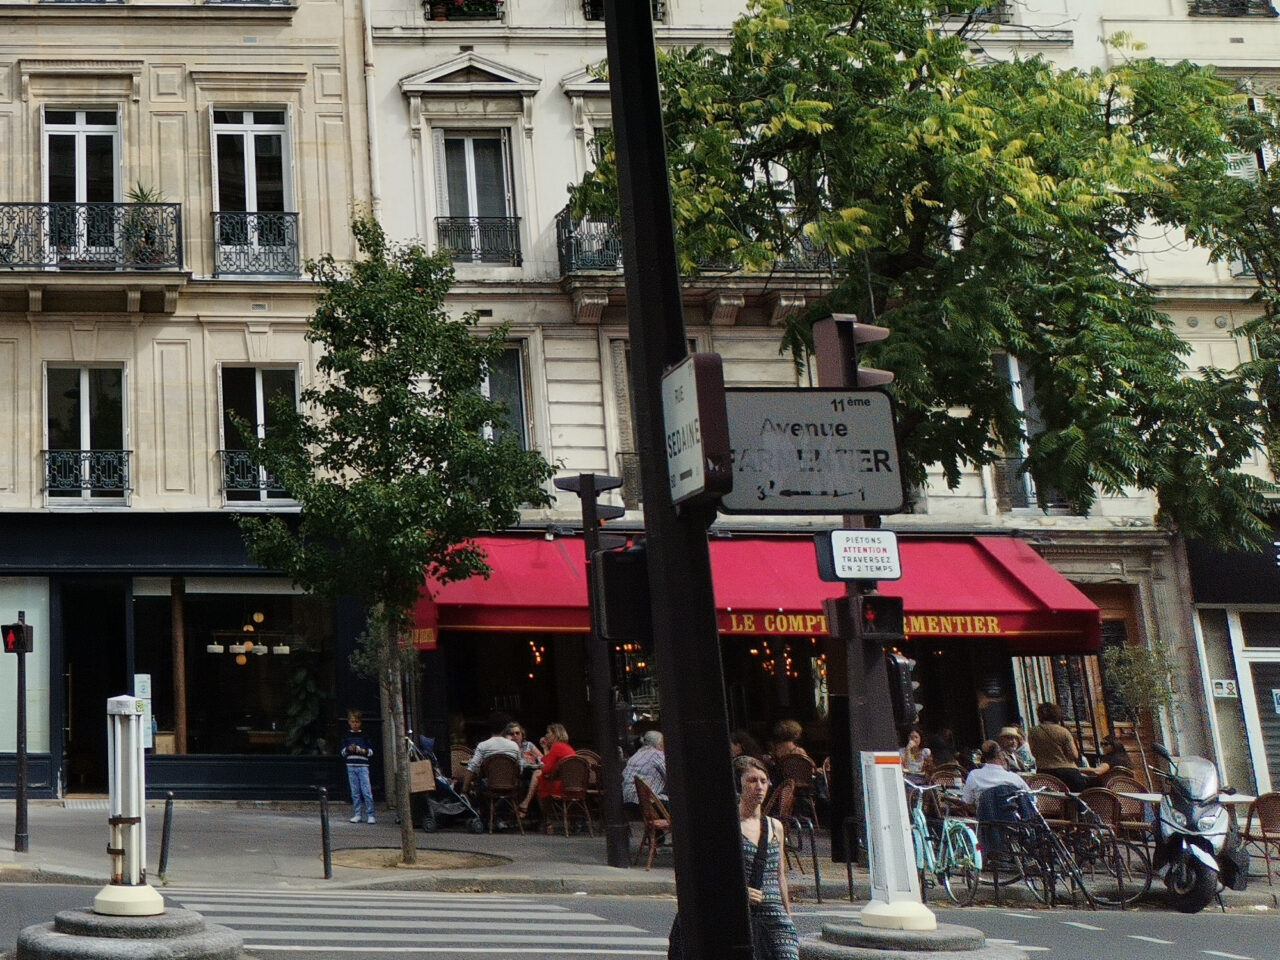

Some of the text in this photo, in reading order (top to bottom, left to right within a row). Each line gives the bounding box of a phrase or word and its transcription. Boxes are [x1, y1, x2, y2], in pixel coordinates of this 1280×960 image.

[759, 417, 848, 437] Avenue
[666, 417, 701, 460] SEDAINE
[730, 614, 1001, 633] LE COMPT MENTIER
